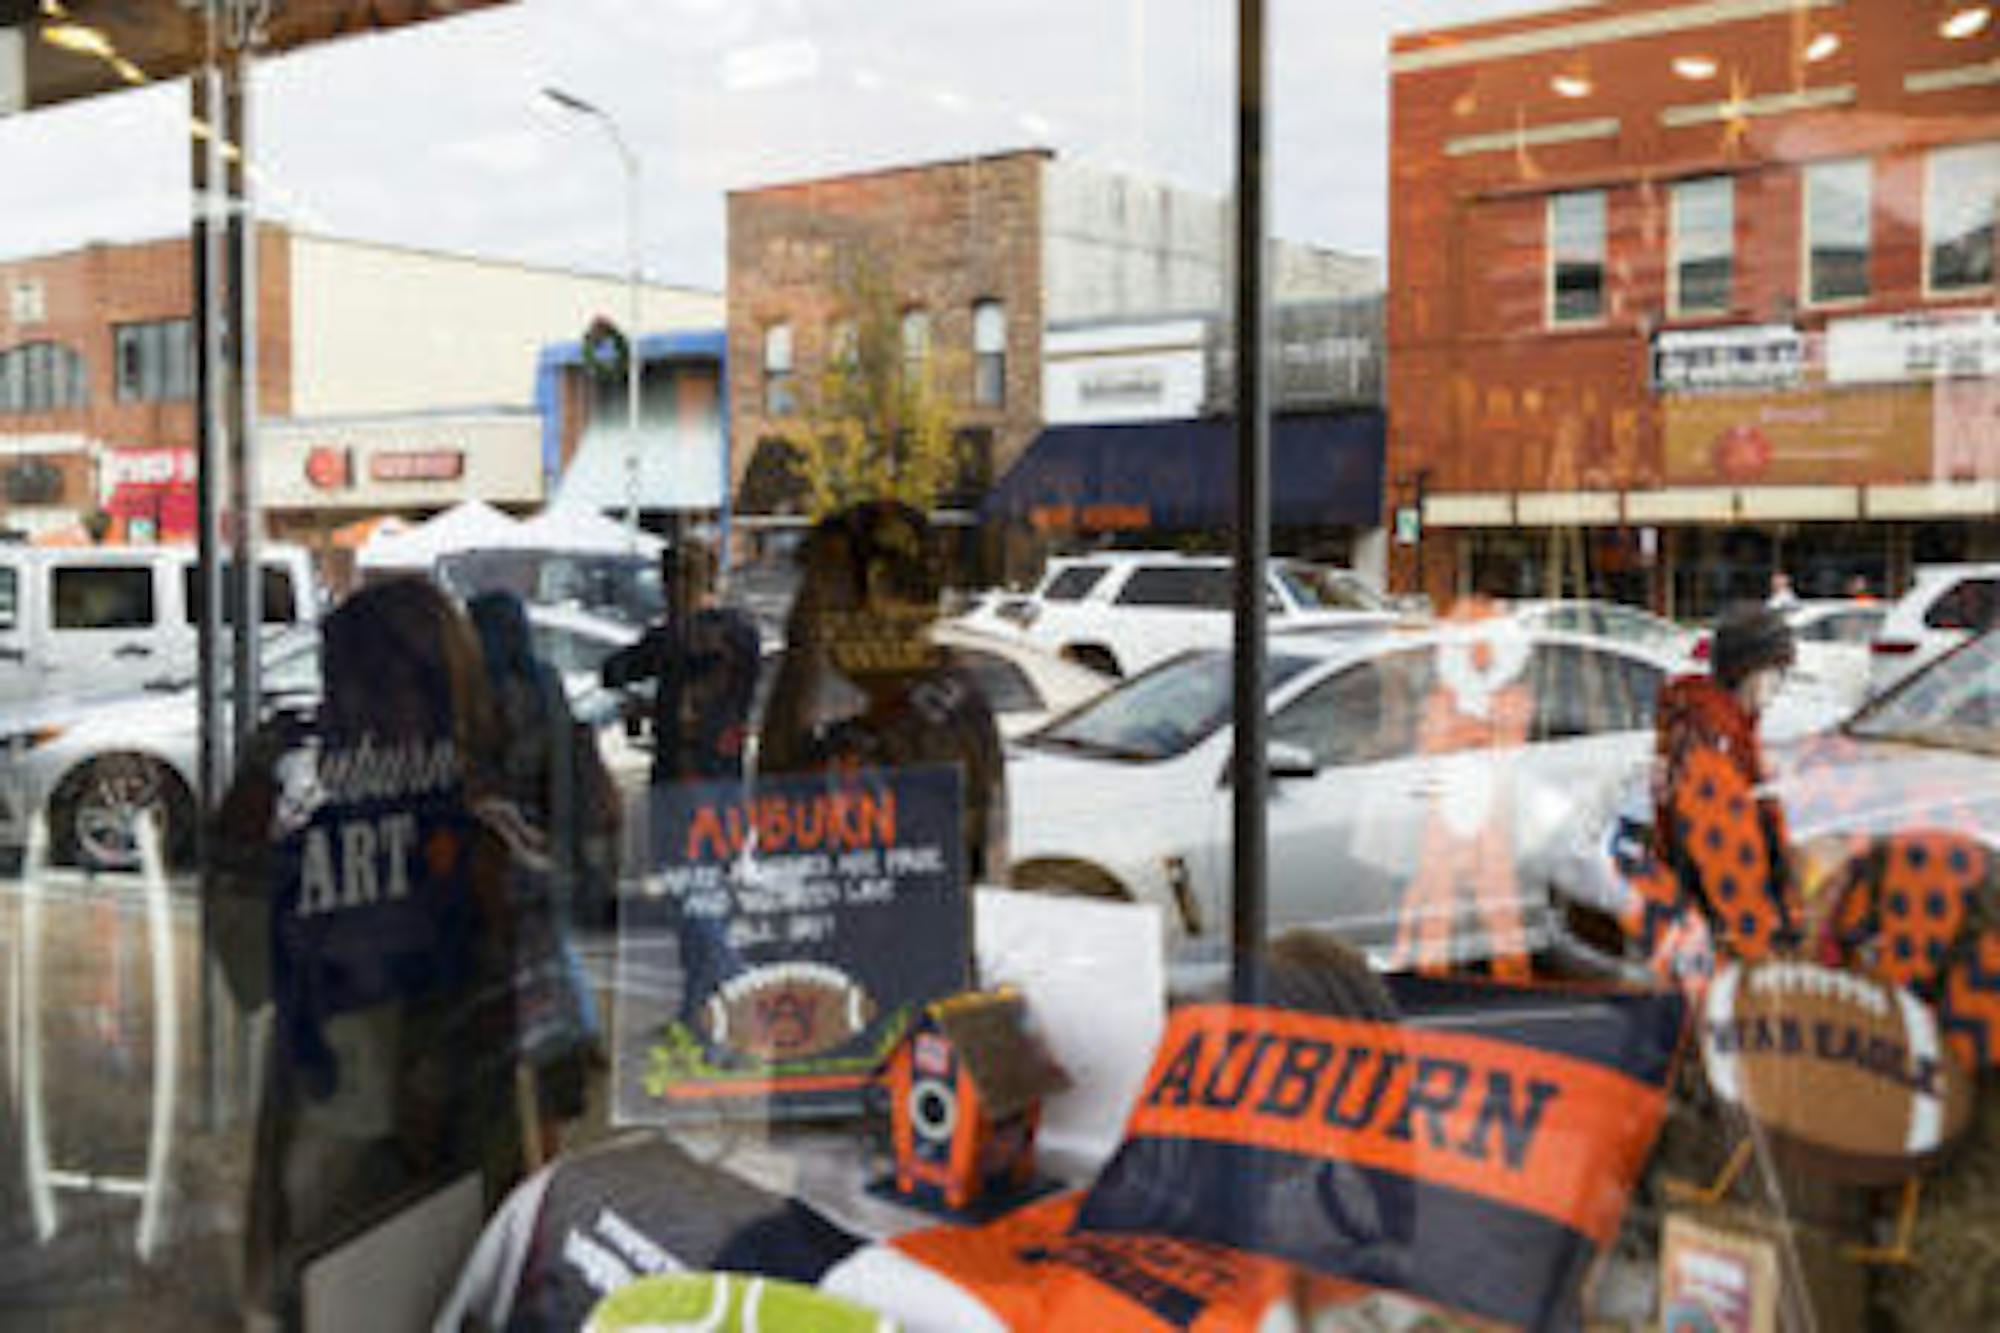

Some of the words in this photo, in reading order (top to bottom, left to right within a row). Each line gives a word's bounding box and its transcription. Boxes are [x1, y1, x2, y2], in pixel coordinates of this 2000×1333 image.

[297, 812, 415, 917] ART
[685, 788, 897, 858] AUBURN
[1148, 1030, 1561, 1168] AUBURN
